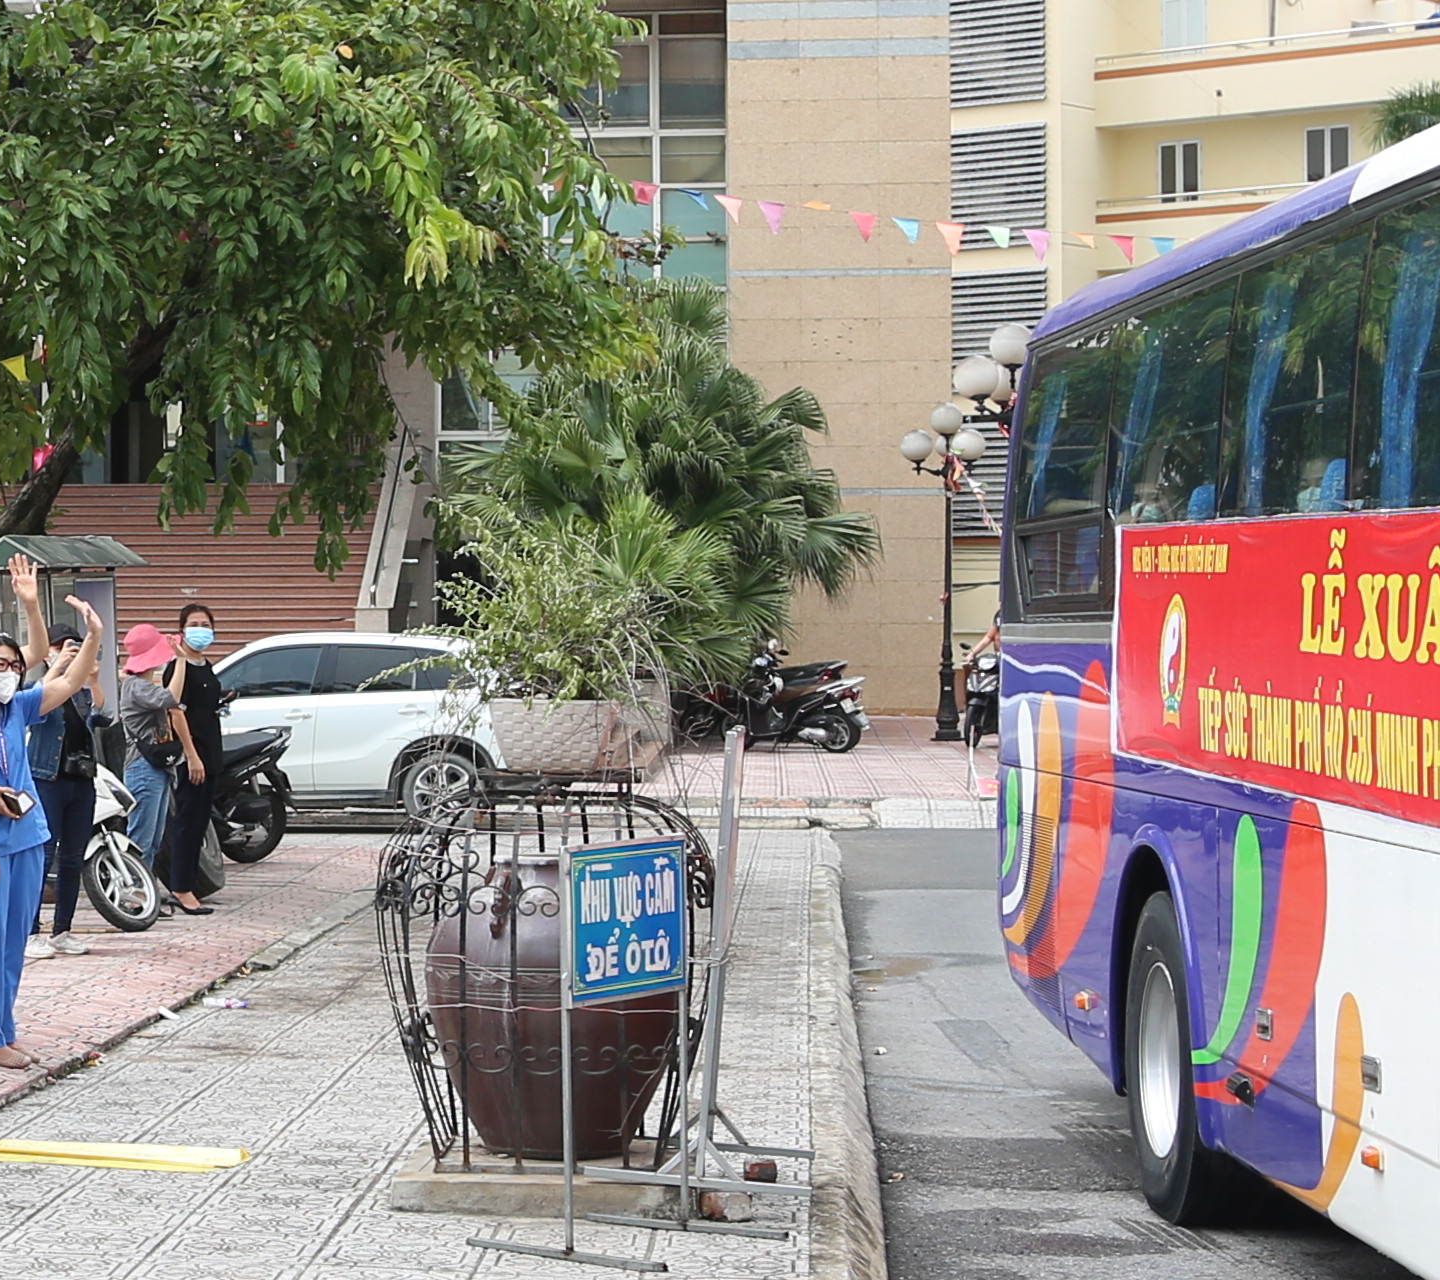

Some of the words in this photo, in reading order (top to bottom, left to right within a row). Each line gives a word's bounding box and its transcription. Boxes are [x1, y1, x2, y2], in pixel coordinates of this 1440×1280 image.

[1299, 528, 1346, 656] LỄ
[1198, 667, 1222, 753] TIẾP
[1224, 677, 1248, 760] SỨC
[1250, 681, 1292, 768] THÀNH
[1294, 676, 1322, 775] PHỐ
[1324, 680, 1344, 780] HỒ
[1346, 694, 1373, 786] CHÍ
[1375, 711, 1419, 796] MINH
[580, 862, 613, 925] KHU
[613, 870, 642, 929] VỰC
[585, 927, 620, 982] ĐỂ
